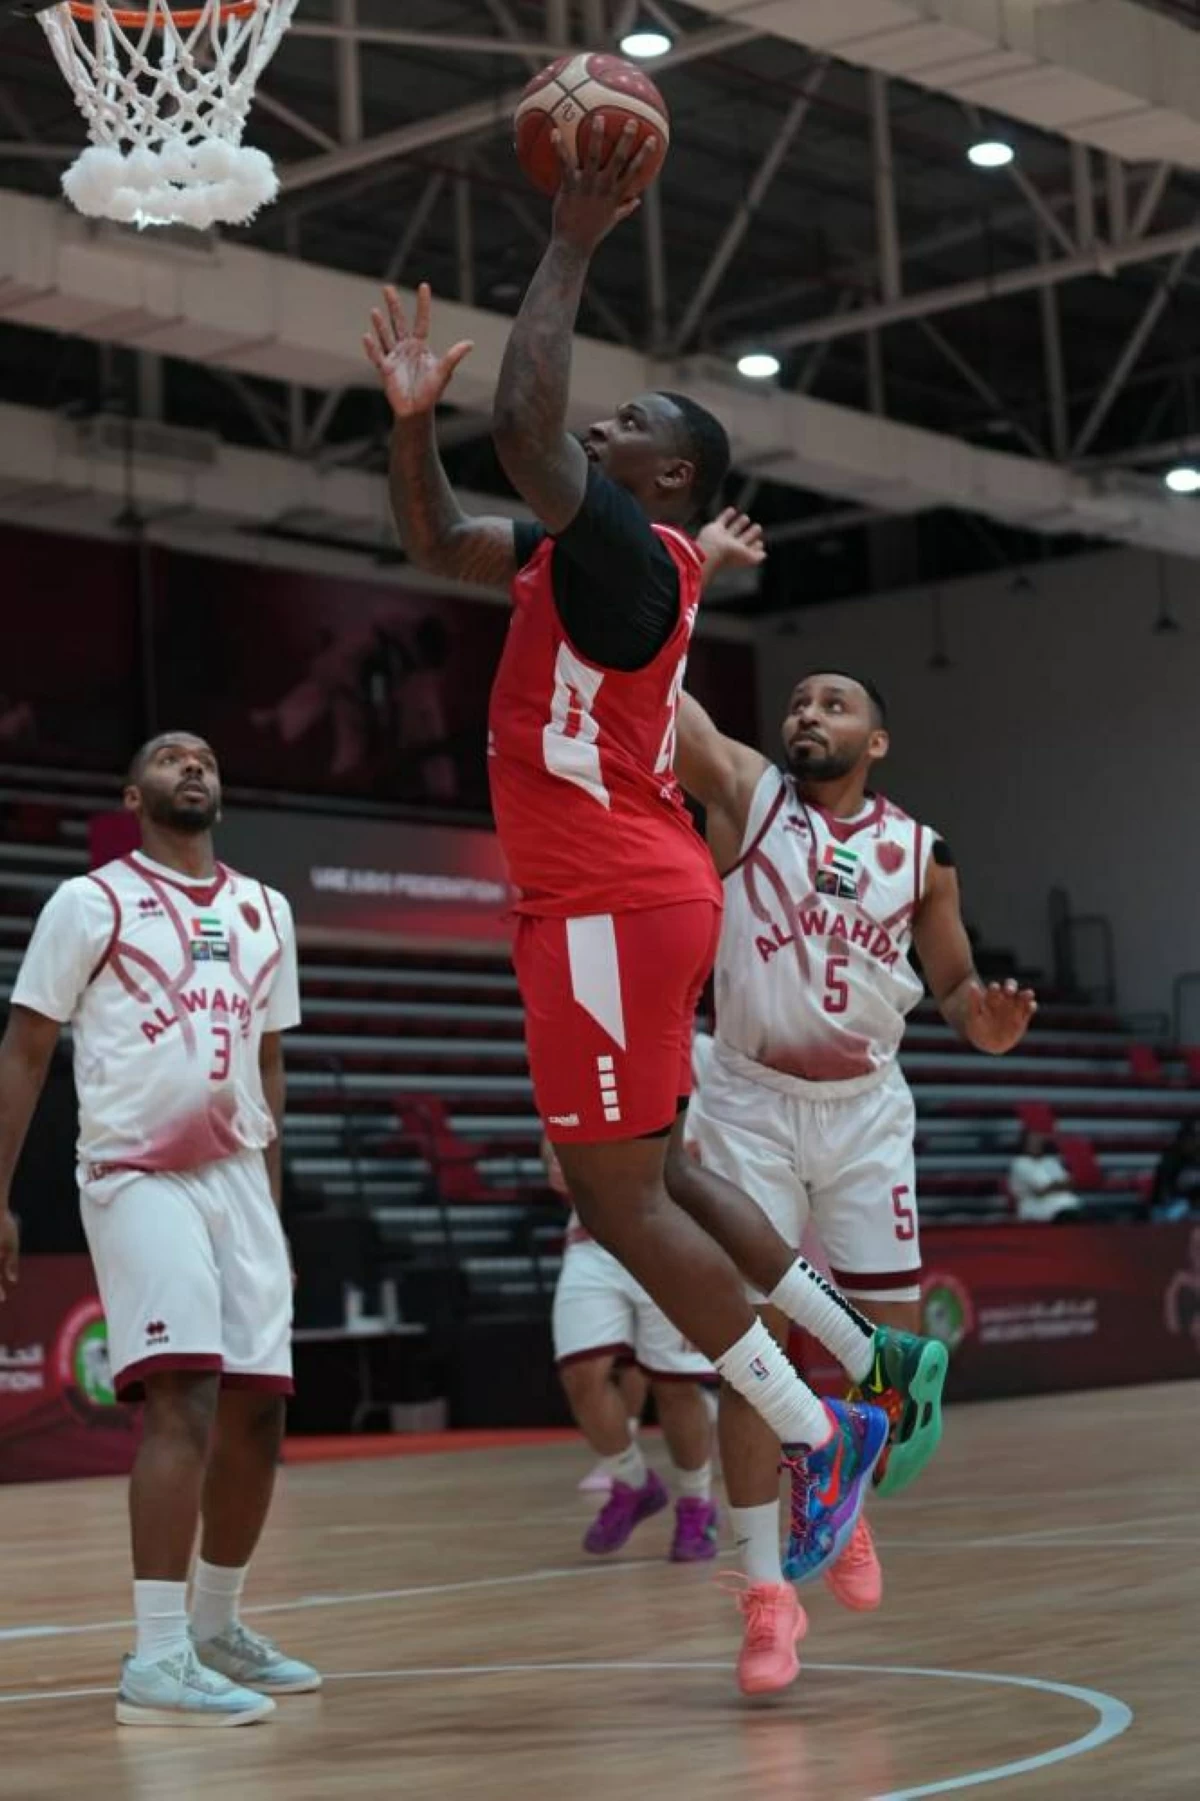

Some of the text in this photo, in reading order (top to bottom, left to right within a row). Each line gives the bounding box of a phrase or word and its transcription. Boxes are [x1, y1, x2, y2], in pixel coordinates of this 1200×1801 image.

[755, 909, 899, 972] AL WAHDA
[823, 957, 848, 1013] 5
[140, 1007, 178, 1043] AL
[209, 1027, 230, 1080] 3
[892, 1185, 914, 1240] 5
